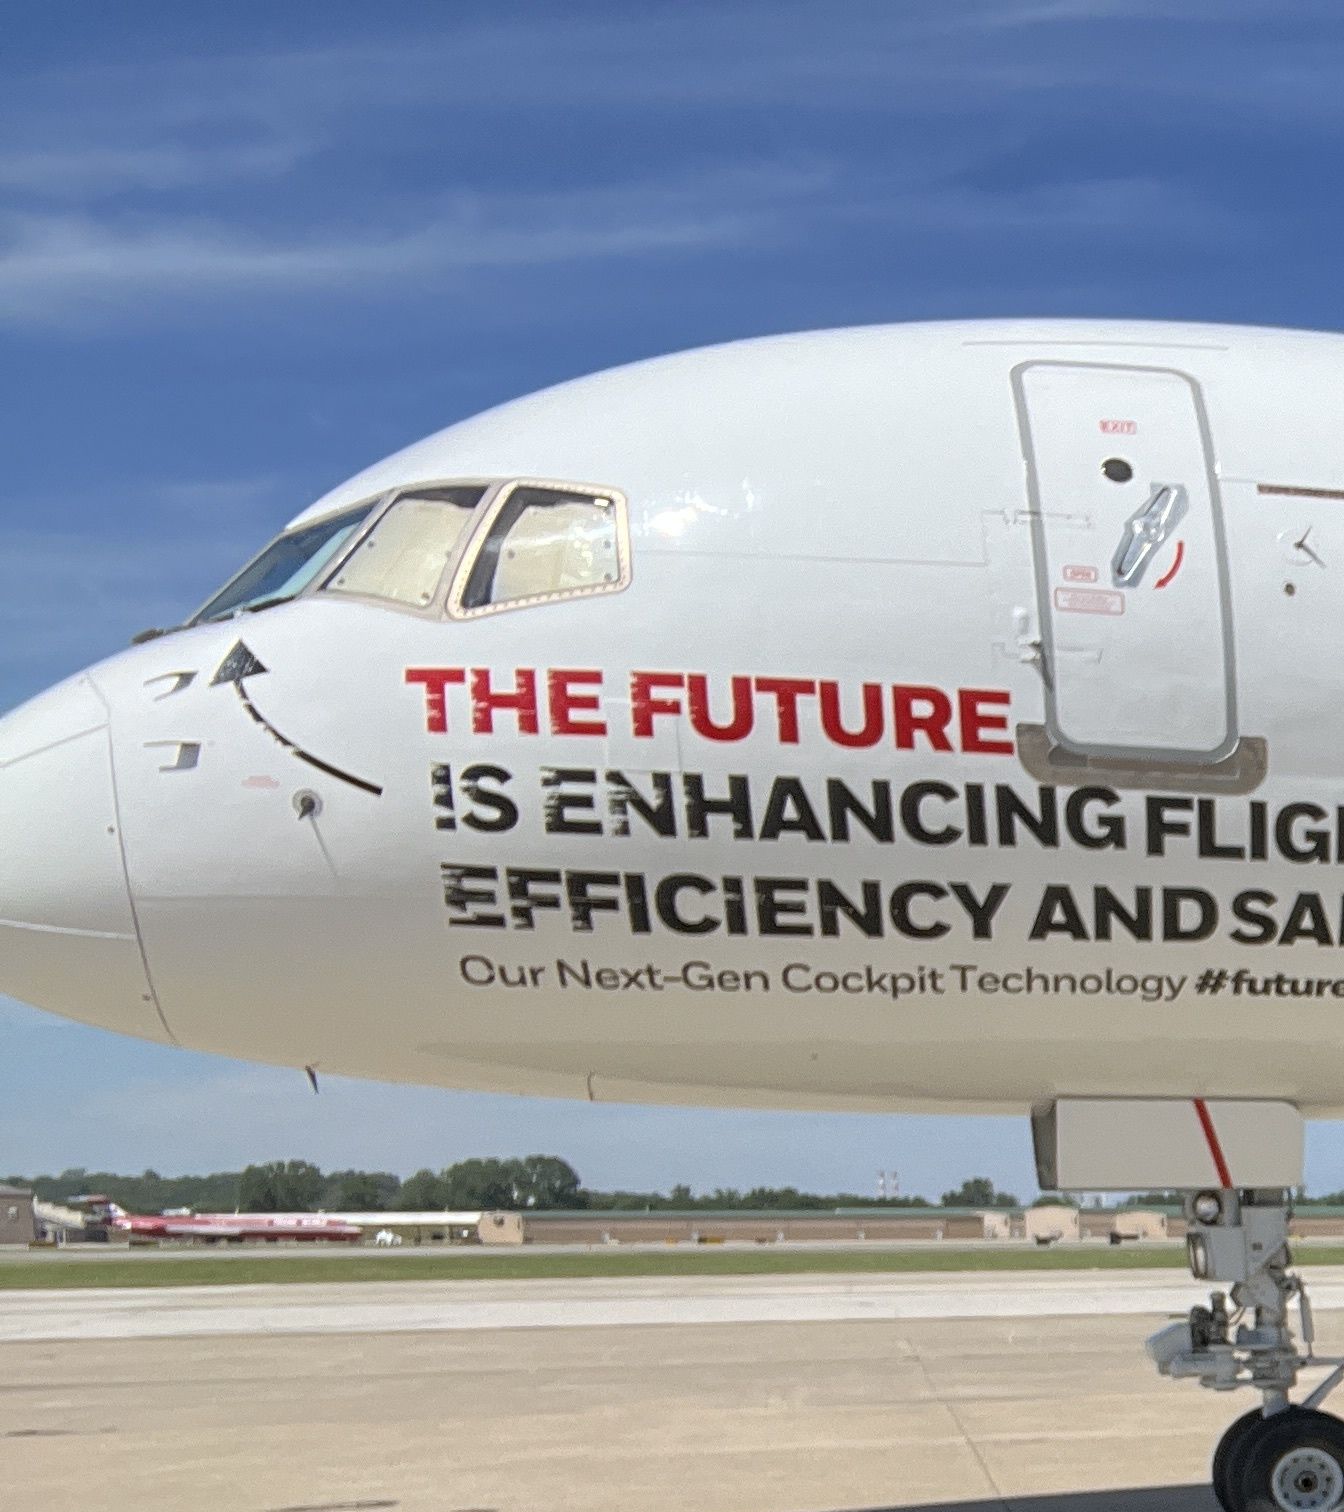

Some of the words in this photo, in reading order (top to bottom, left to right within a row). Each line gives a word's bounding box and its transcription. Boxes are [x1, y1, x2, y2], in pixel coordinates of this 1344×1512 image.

[404, 668, 607, 736] THE
[630, 671, 1014, 755] FUTURE
[431, 762, 519, 833] IS
[541, 766, 1126, 848] ENHANCING
[440, 863, 1011, 939] EFFICIENCY
[1028, 884, 1219, 941] AND
[460, 955, 545, 988] Our
[557, 959, 770, 992] Next-Gen
[781, 962, 944, 999] Cockpit
[950, 964, 1187, 1001] Technology
